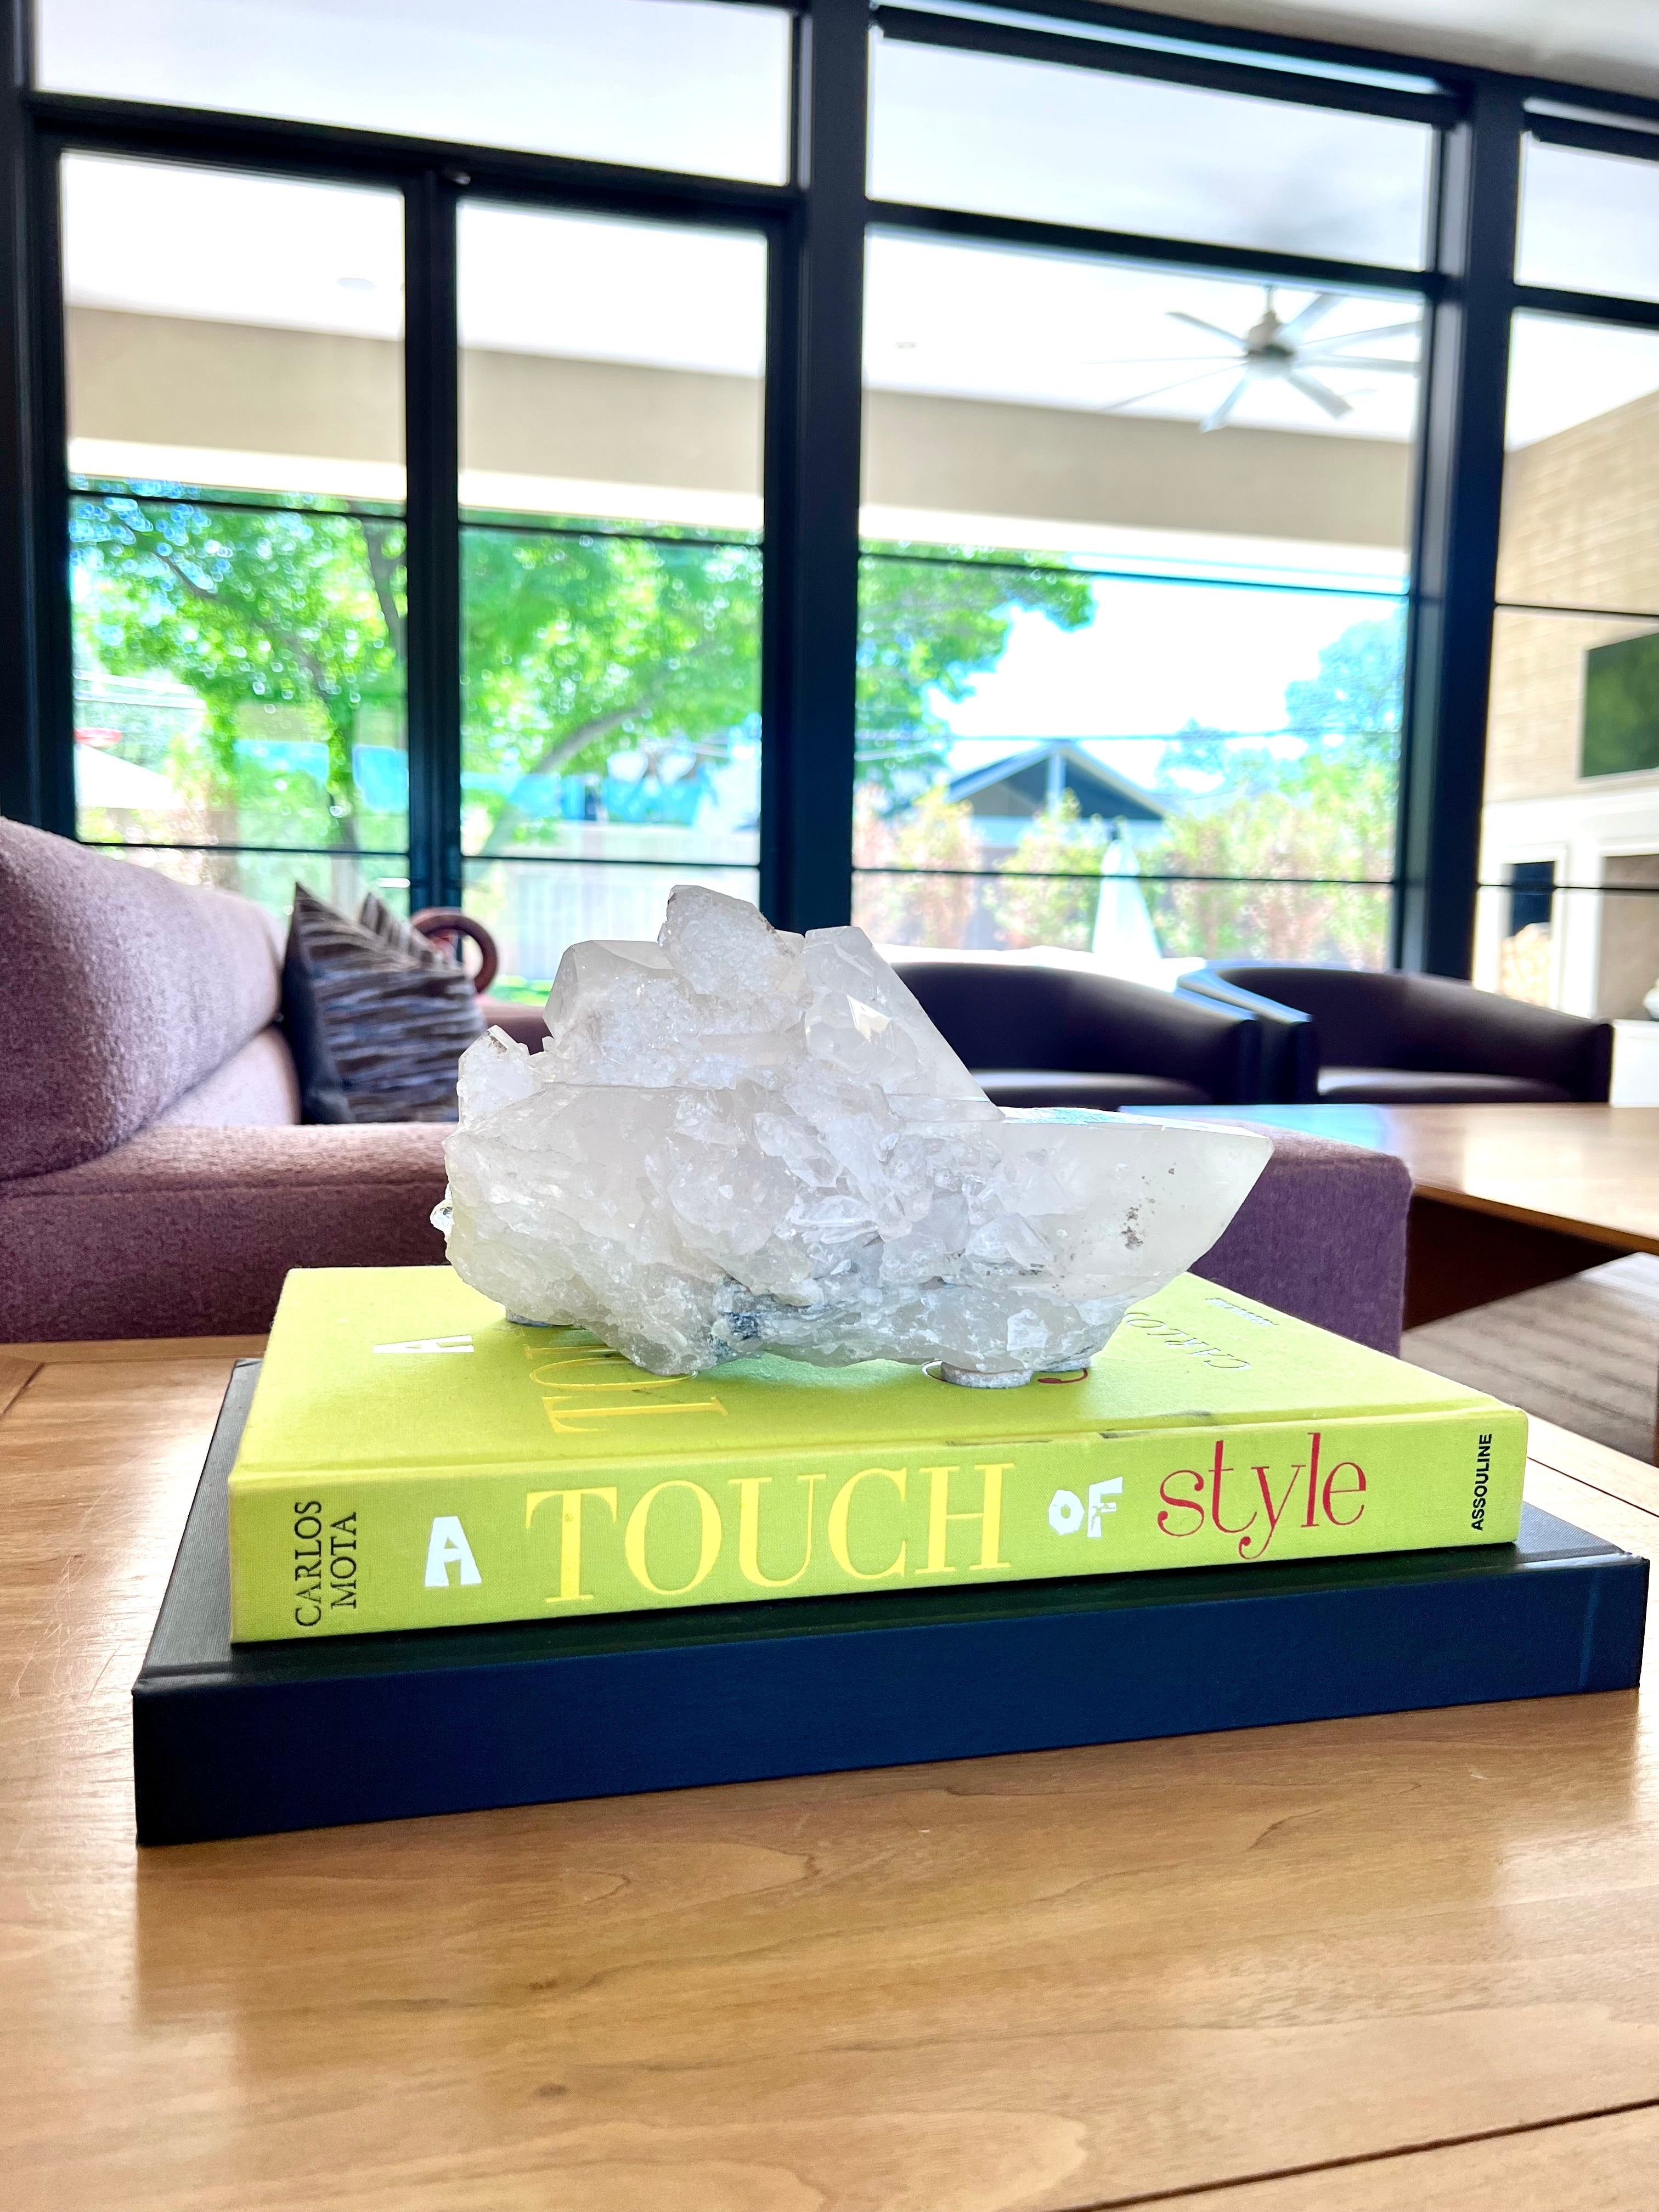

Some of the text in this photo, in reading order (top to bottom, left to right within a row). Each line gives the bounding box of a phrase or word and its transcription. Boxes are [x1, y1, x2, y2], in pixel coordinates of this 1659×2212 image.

[425, 1432, 1367, 1604] A TOUCH OF style
[1471, 1433, 1493, 1532] ASSOULINE
[294, 1499, 323, 1628] CARLOS
[330, 1511, 357, 1610] MOTA
